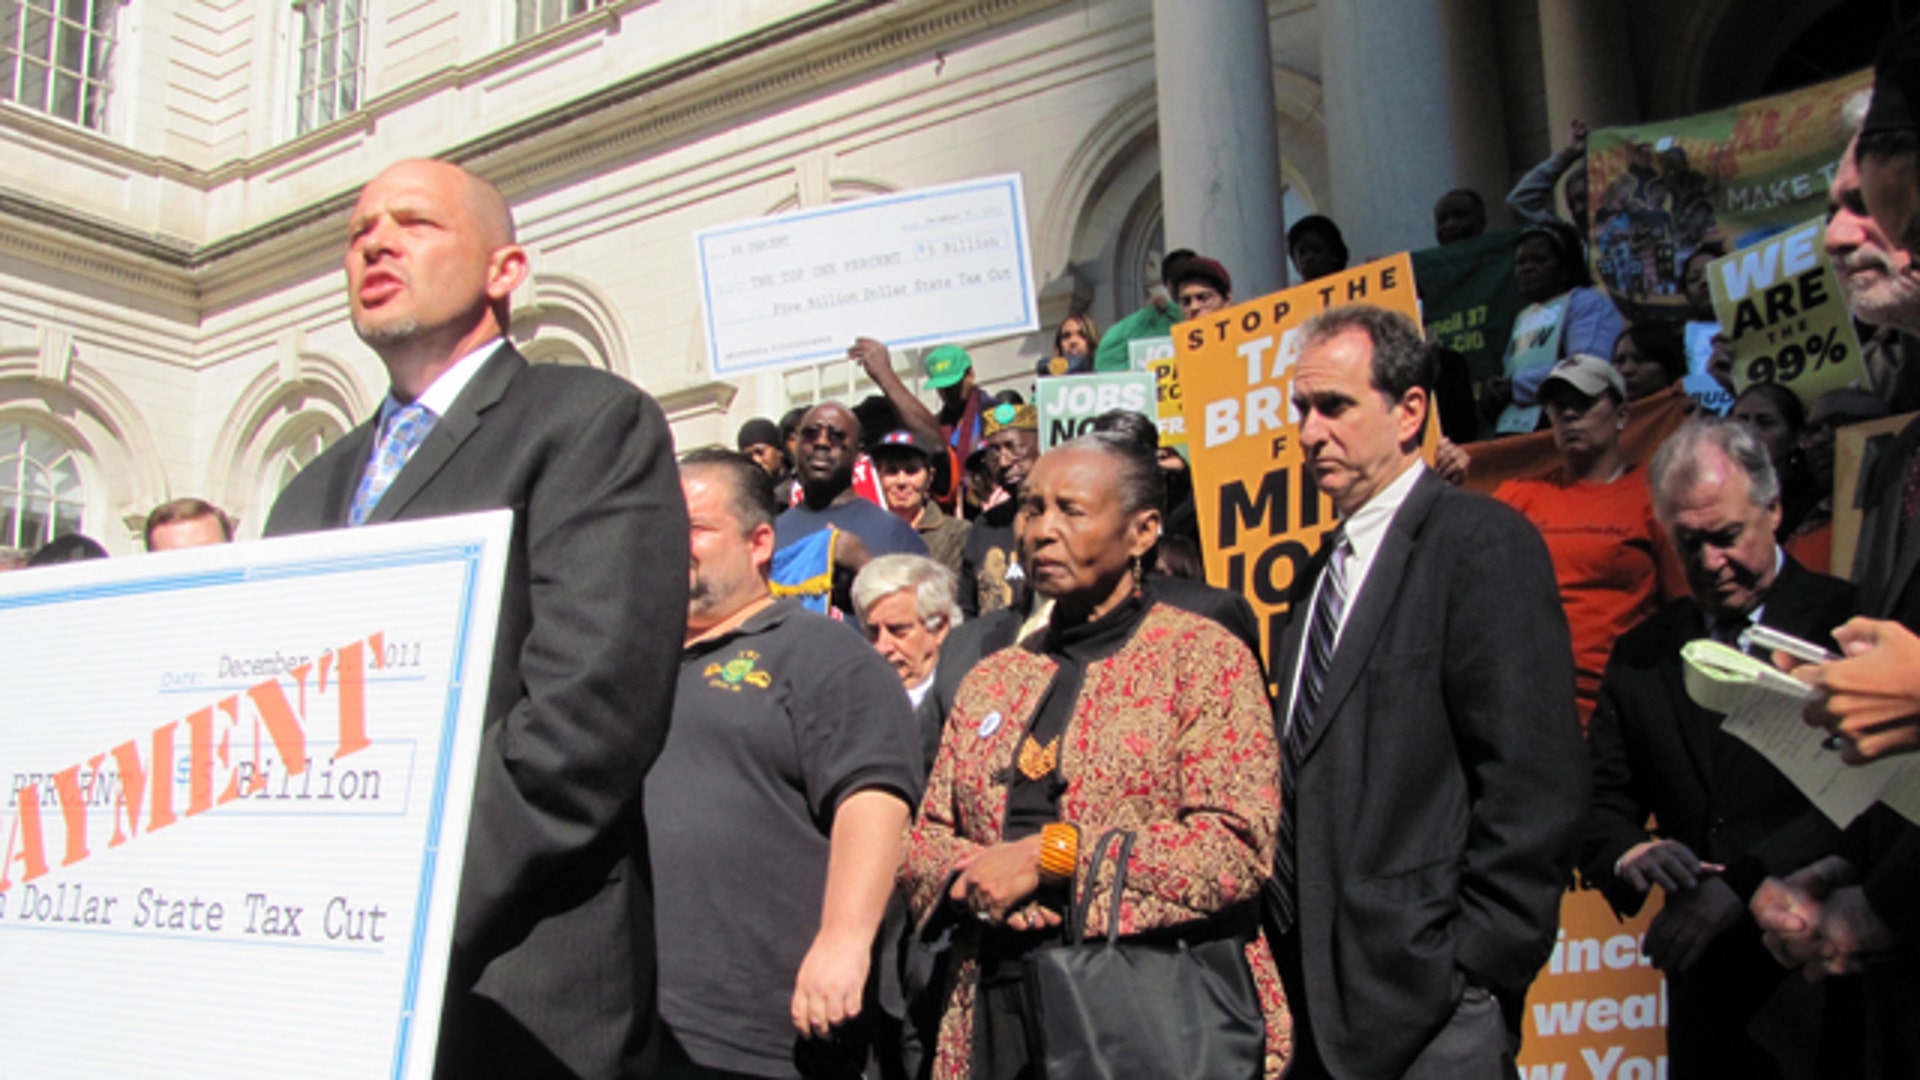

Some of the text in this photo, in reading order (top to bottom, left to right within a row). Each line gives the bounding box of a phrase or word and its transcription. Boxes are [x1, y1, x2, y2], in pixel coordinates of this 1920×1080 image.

[1727, 174, 1814, 211] MAKE
[942, 236, 1000, 254] Billion
[1721, 224, 1819, 302] WE
[752, 251, 902, 289] THE TOP ONE PERCENT
[772, 267, 1013, 316] Five Billion Dollar State Tax Cut
[1187, 267, 1398, 350] STOP THE
[1731, 266, 1829, 340] ARE
[1766, 319, 1808, 345] THE
[1747, 326, 1848, 384] 99%
[1045, 382, 1147, 416] JOBS
[217, 651, 311, 679] December
[0, 630, 384, 892] AYMENT
[237, 757, 382, 801] Billion
[8, 773, 134, 808] PERENT
[19, 883, 118, 926] Dollar
[133, 887, 226, 933] State
[243, 893, 304, 937] Tax
[322, 896, 388, 943] Cut
